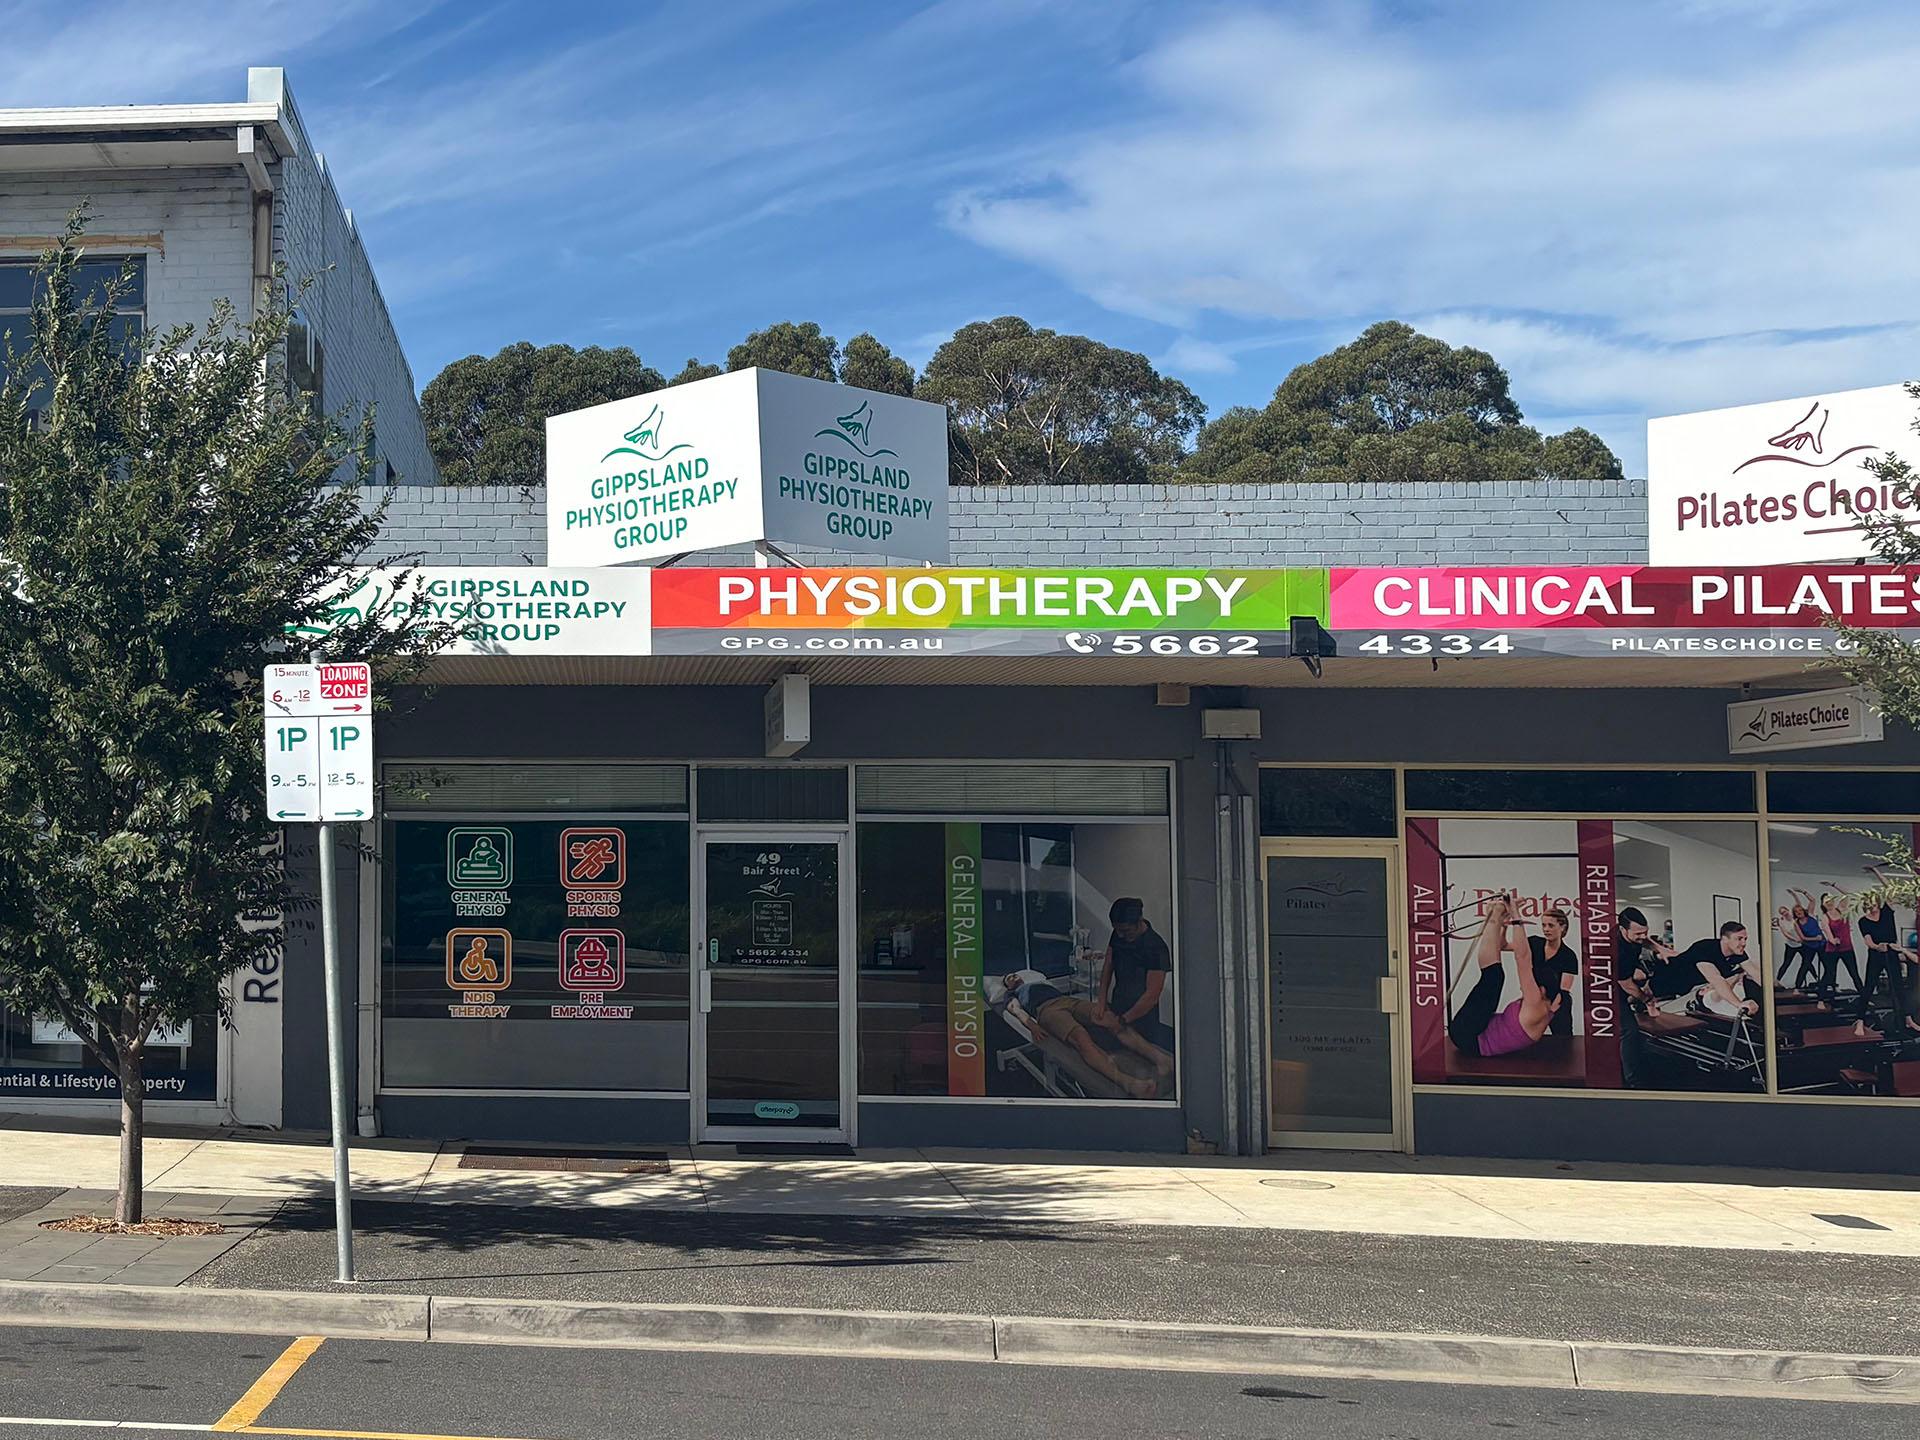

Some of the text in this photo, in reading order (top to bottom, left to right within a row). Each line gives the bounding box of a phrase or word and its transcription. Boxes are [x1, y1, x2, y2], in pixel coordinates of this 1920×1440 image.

[591, 457, 709, 500] GIPPSLAND
[804, 452, 911, 490] GIPPSLAND
[566, 477, 738, 530] PHYSIOTHERAPY
[779, 476, 933, 520] PHYSIOTHERAPY
[613, 517, 688, 549] GROUP
[827, 511, 893, 541] GROUP
[429, 579, 590, 598] GIPPSLAND
[718, 576, 1246, 617] PHYSIOTHERAPY
[1373, 574, 1920, 617] CLINICAL PILATE
[720, 637, 944, 651] GPG.com.au
[1111, 634, 1515, 656] 5662 4334
[274, 668, 285, 677] 15
[322, 667, 366, 681] LOADING
[321, 683, 367, 697] ZONE
[277, 727, 307, 752] 1P
[330, 726, 360, 751] 1P
[755, 852, 781, 865] 49
[743, 866, 800, 876] Bair Street
[451, 891, 511, 904] GENERAL
[566, 891, 622, 903] SPORTS
[456, 904, 506, 917] PHYSIO
[567, 905, 621, 918] PHYSIO
[1413, 884, 1438, 1007] ALL LEVELS
[1586, 864, 1614, 1038] REHABILITATION
[953, 855, 977, 1058] GENERAL PHYSIO
[463, 991, 496, 1004] NDIS
[579, 992, 604, 1004] PRE
[448, 1005, 511, 1018] THERAPY
[551, 1005, 634, 1019] EMPLOYMENT
[0, 1073, 186, 1093] ntial & Lifestyle perty
